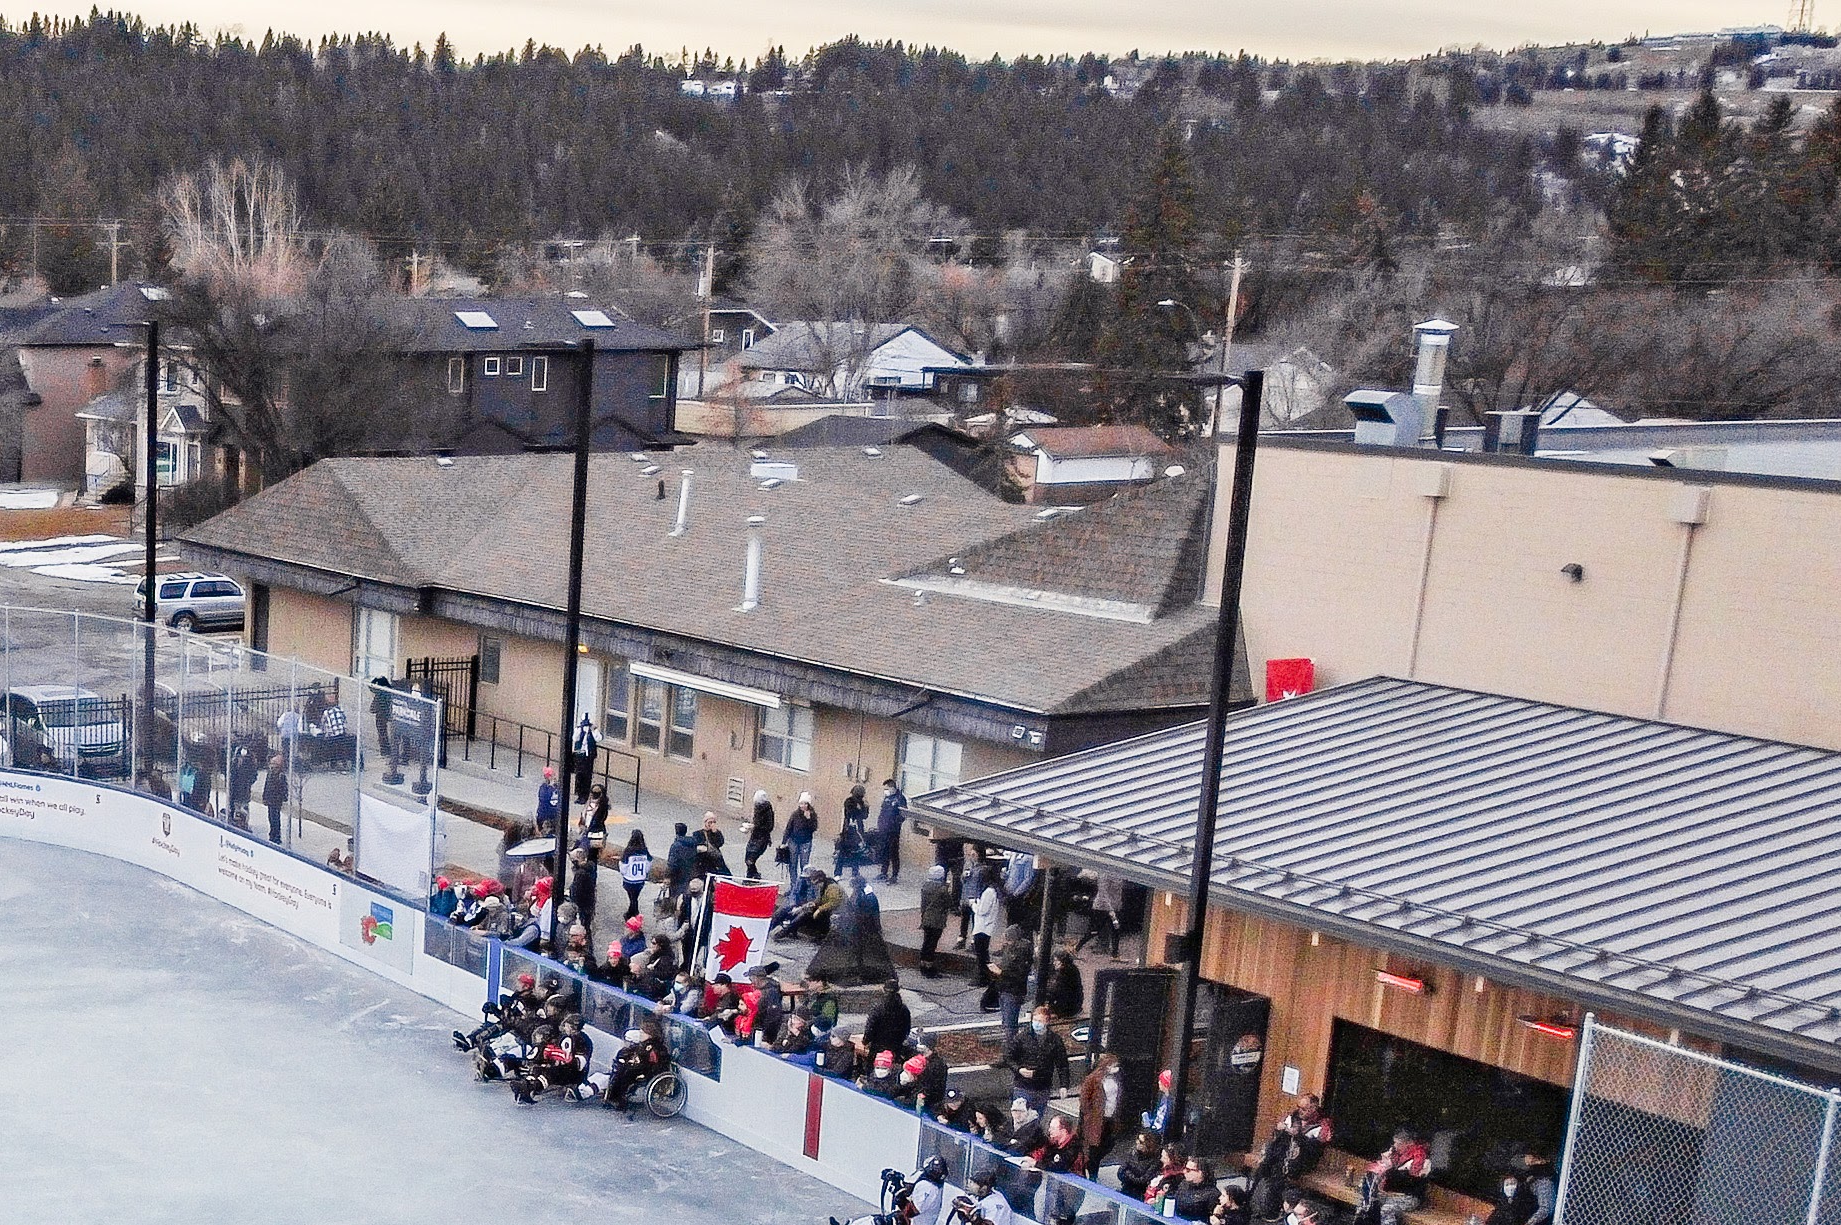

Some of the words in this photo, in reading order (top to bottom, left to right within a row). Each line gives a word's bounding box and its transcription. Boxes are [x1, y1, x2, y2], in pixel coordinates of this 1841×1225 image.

[0, 795, 9, 803] all
[47, 802, 58, 810] we
[632, 863, 644, 877] 04
